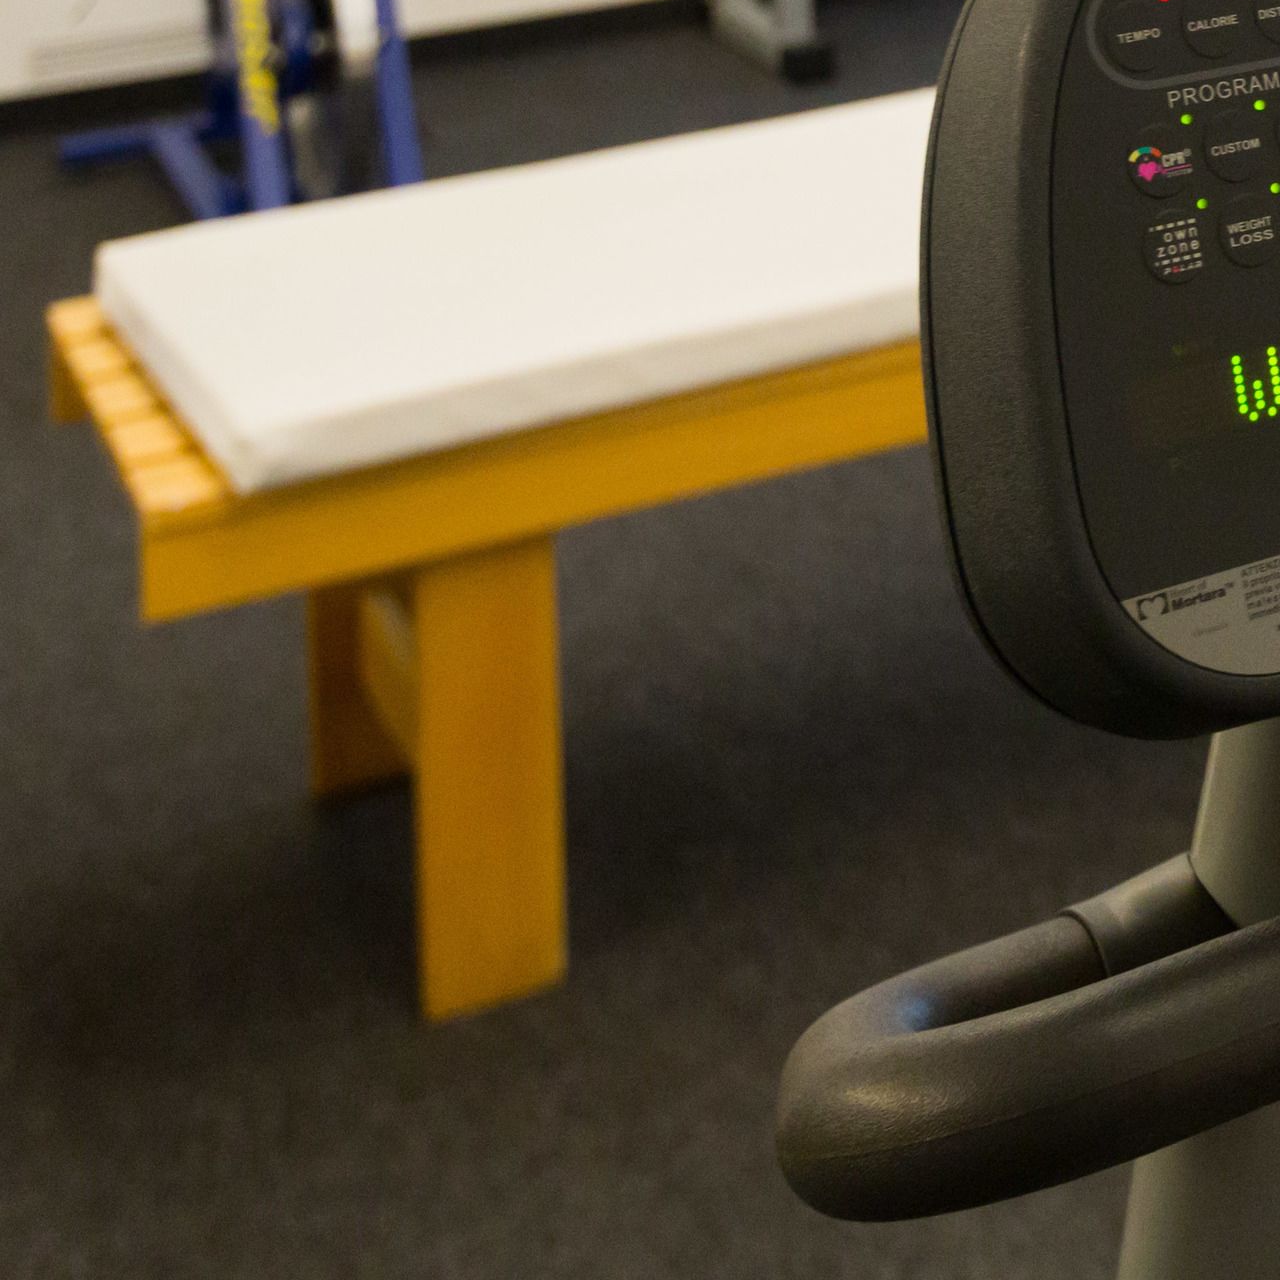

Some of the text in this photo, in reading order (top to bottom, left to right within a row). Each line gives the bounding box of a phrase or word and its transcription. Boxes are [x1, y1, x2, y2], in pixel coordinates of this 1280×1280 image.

[1187, 14, 1239, 32] CALORIE
[1117, 28, 1161, 45] TEMPO
[1166, 71, 1280, 109] PROGRAM
[1210, 138, 1261, 157] CUSTOM
[1227, 216, 1272, 234] WEIGHT
[1163, 226, 1198, 243] own
[1229, 229, 1274, 248] LOSS
[1157, 240, 1200, 258] zone
